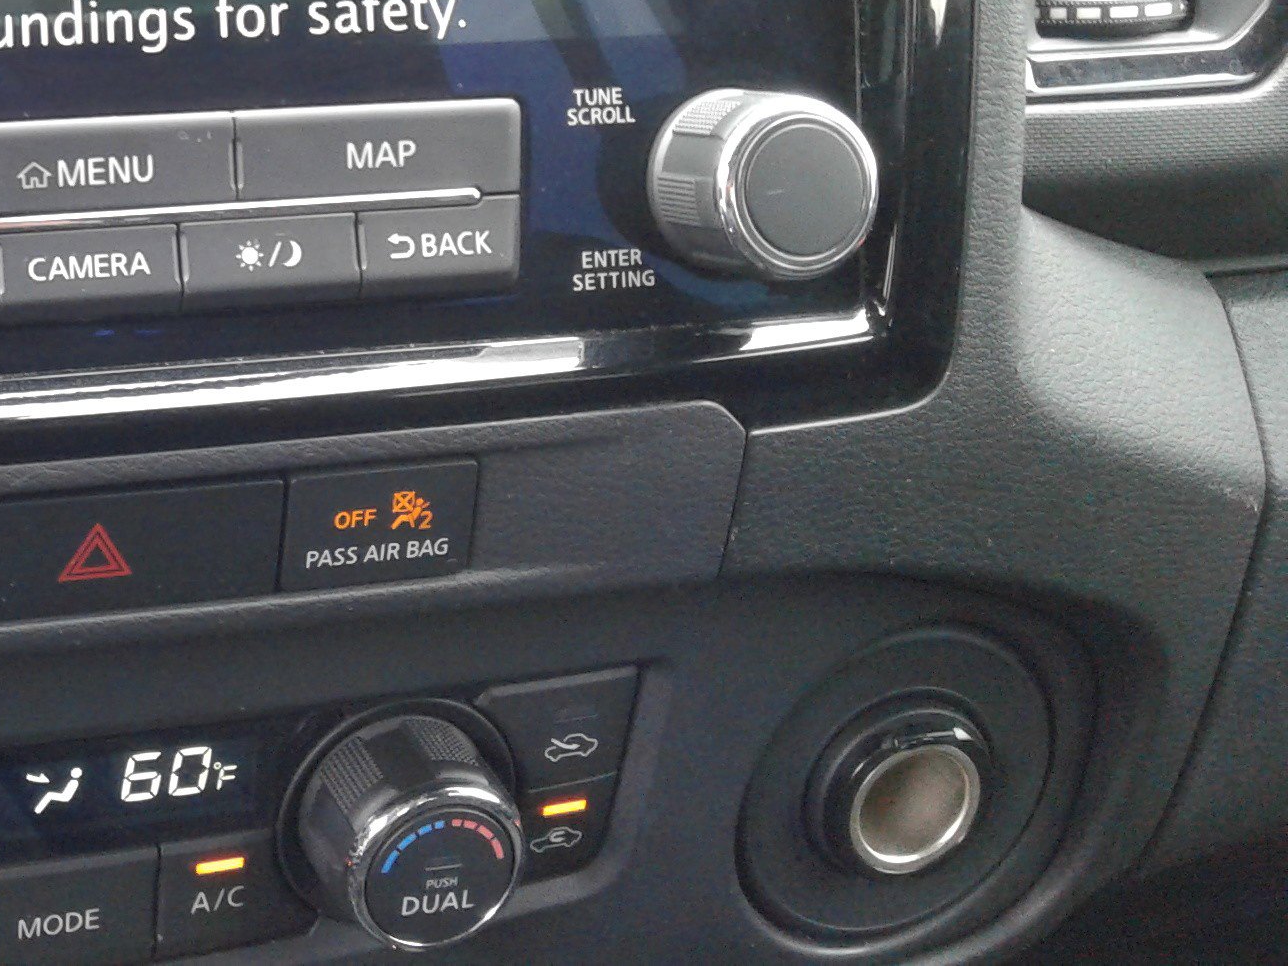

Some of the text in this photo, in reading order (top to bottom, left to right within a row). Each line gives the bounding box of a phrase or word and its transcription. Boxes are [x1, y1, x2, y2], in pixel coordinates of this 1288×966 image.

[572, 87, 624, 107] TUNE
[567, 106, 636, 126] SCROLL
[345, 140, 418, 170] MAP
[56, 153, 154, 188] MENU
[420, 230, 493, 259] BACK
[27, 251, 152, 283] CAMERA
[581, 248, 644, 270] ENTER
[572, 269, 657, 293] SETTING
[333, 508, 378, 531] OFF
[304, 536, 450, 570] PASS AIR BAG
[425, 876, 460, 890] PUSH
[189, 885, 246, 916] A/C
[400, 889, 476, 917] DUAL
[16, 908, 101, 941] MODE
